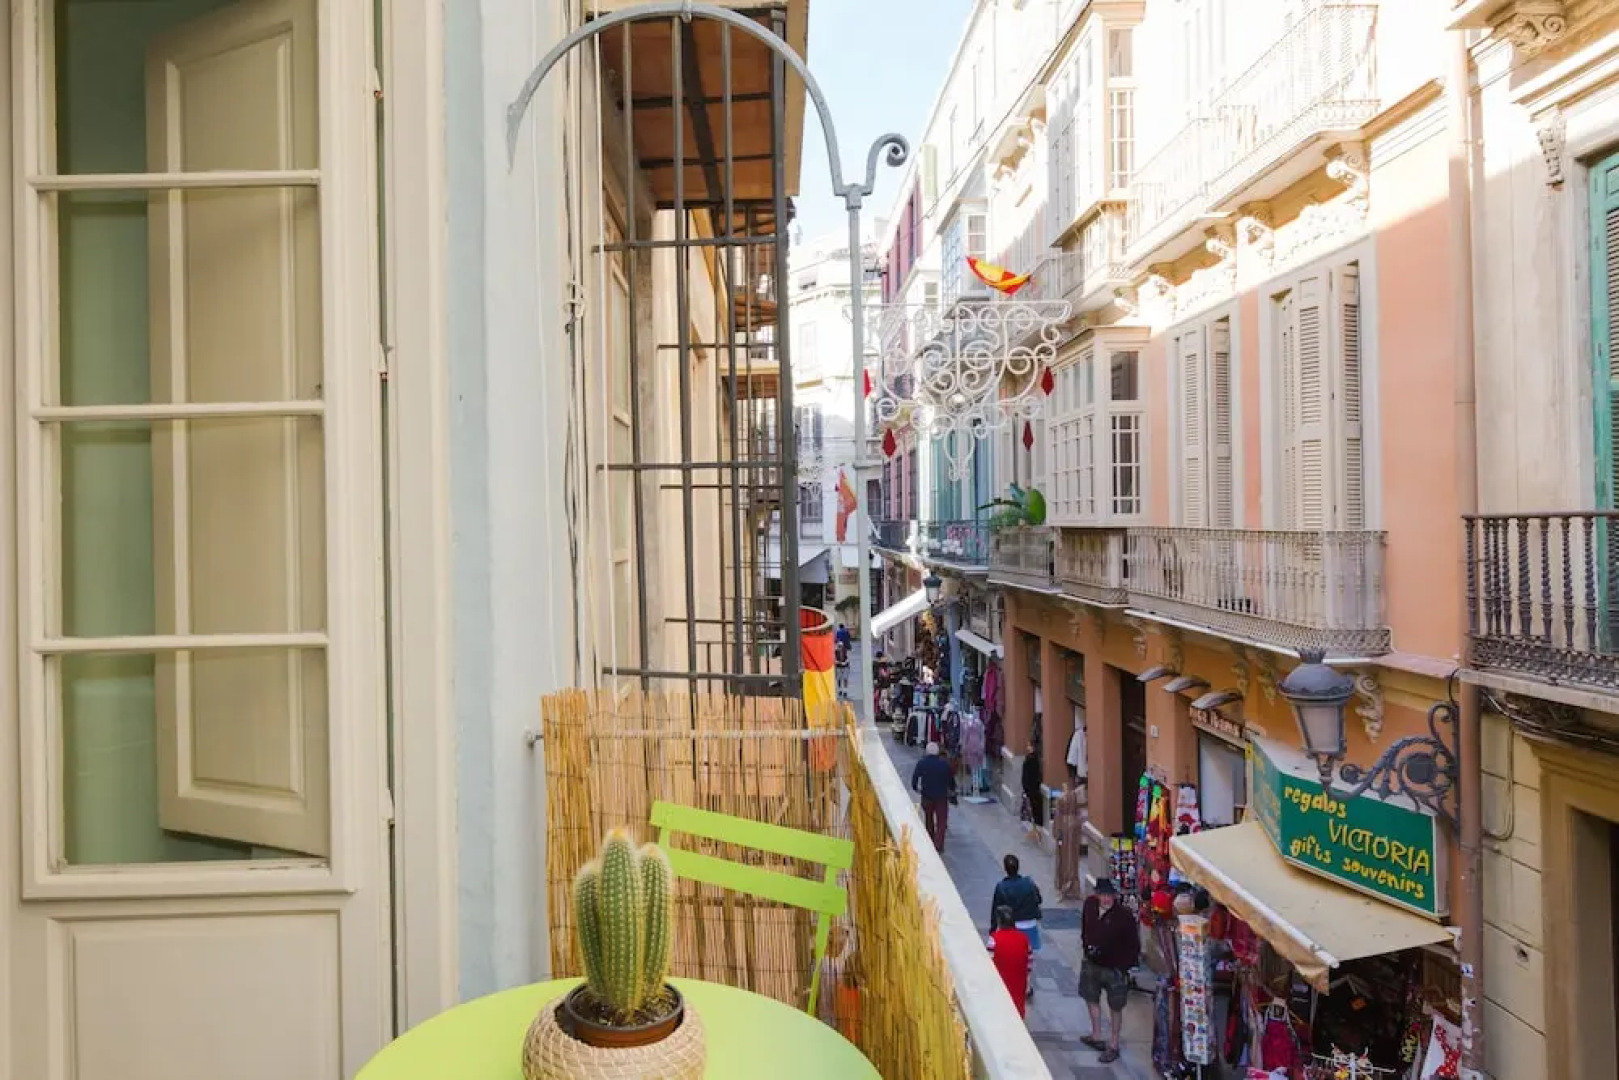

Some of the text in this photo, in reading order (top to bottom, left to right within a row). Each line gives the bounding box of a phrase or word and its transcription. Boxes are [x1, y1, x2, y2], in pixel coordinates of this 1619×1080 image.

[1284, 786, 1347, 818] regalos
[1290, 835, 1425, 899] gifts souvenirs
[1328, 818, 1430, 876] VICTORIA
